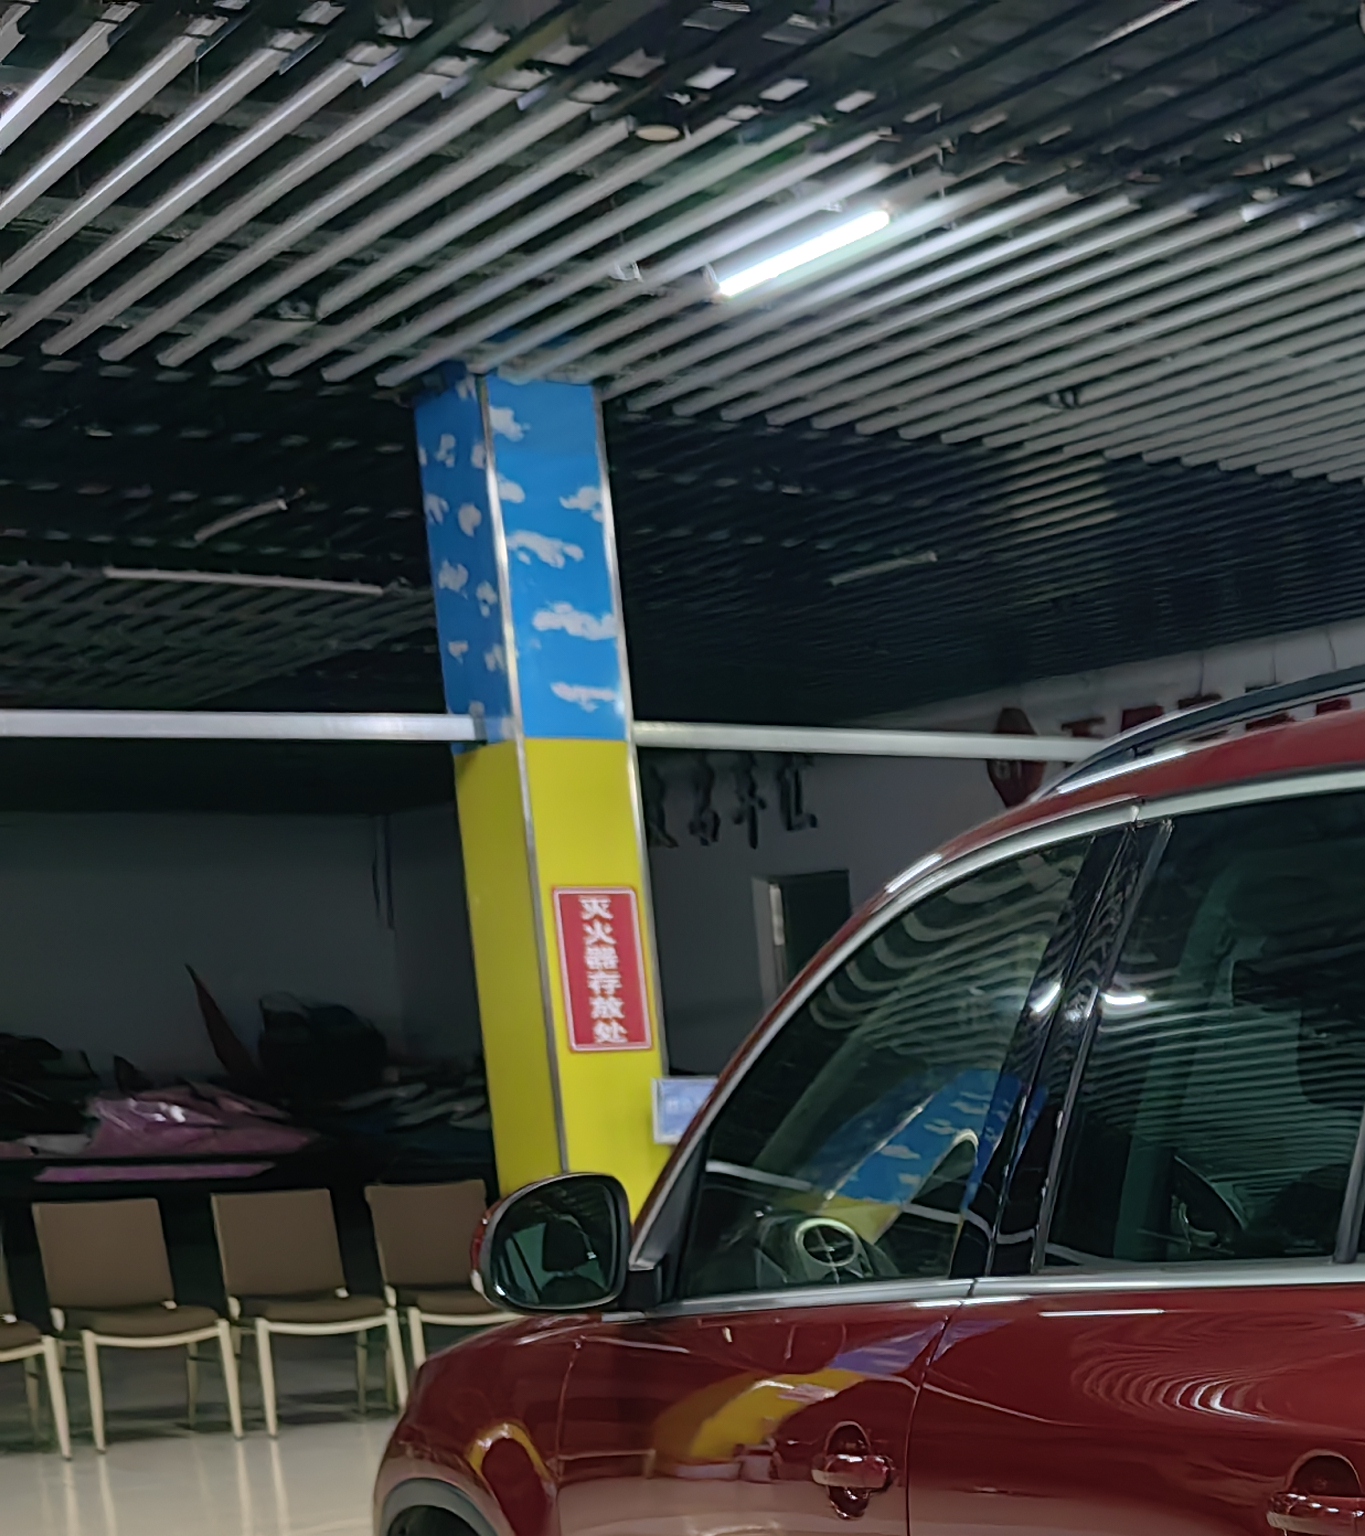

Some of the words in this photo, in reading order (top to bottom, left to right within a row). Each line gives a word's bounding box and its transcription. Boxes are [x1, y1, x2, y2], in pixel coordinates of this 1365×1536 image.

[579, 897, 628, 1043] 灭火器存放处
